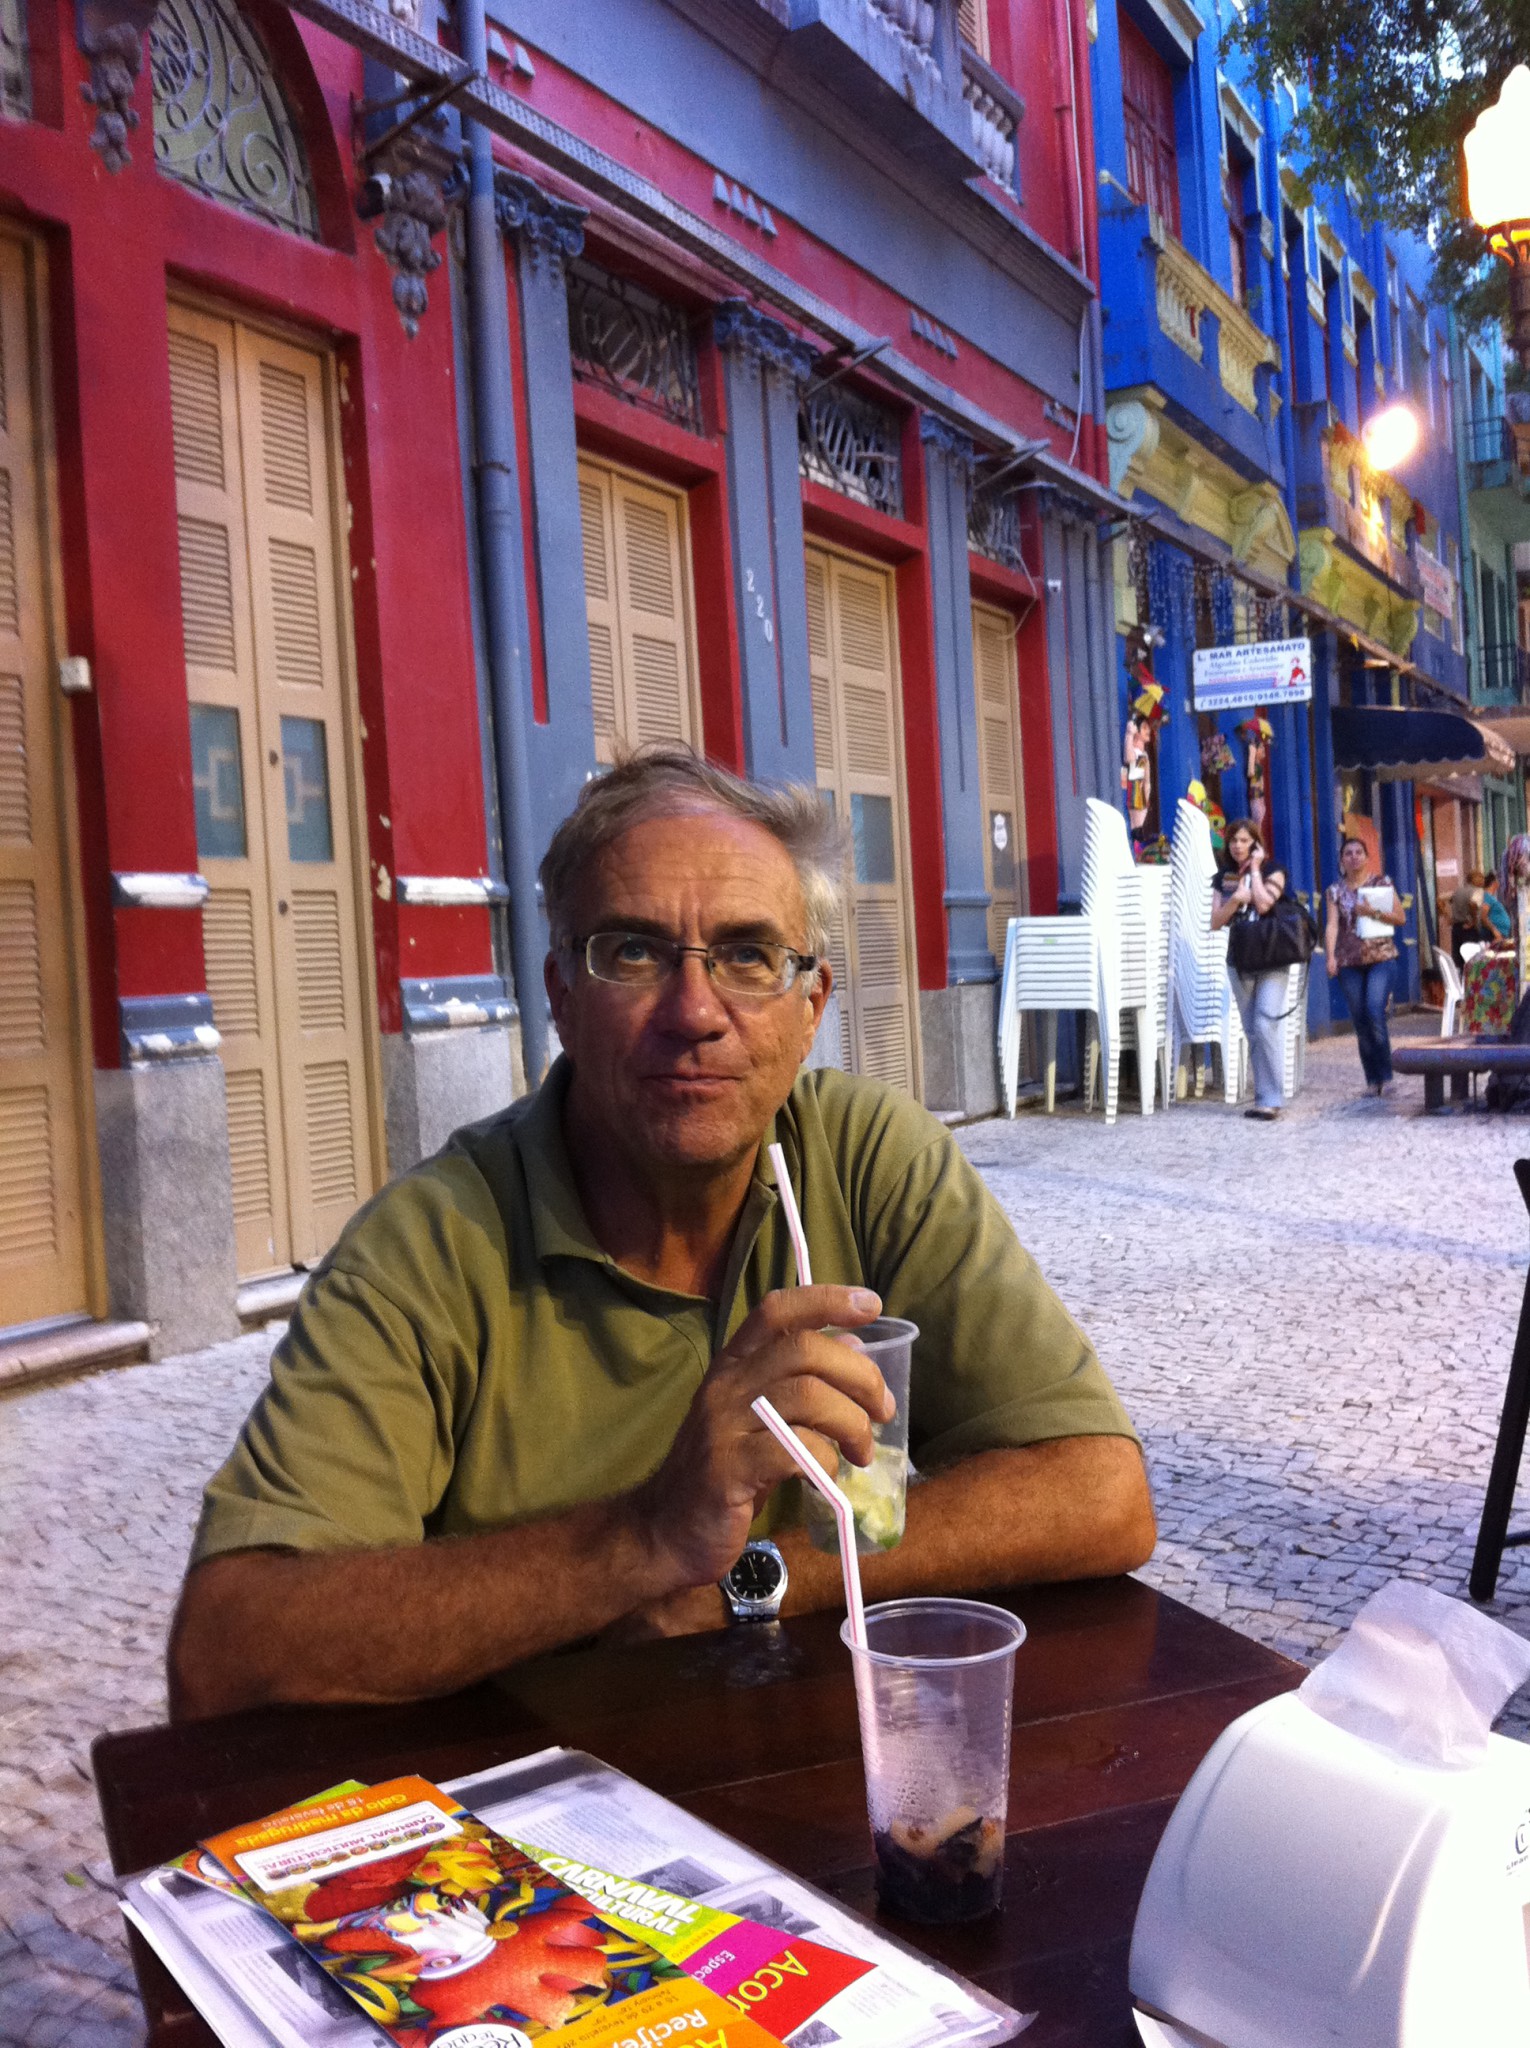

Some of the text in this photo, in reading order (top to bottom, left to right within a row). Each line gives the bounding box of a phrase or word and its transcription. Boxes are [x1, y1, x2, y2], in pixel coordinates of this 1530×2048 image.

[746, 569, 773, 642] 220
[1210, 651, 1232, 660] MAR
[1236, 642, 1305, 658] ARTESANATO
[342, 1806, 363, 1817] da
[366, 1794, 407, 1811] Galo
[235, 1813, 338, 1847] madrugada
[370, 1814, 435, 1839] CARNAVAL
[257, 1837, 366, 1870] MULTICULTURAL
[539, 1857, 700, 1924] CARNAVAL
